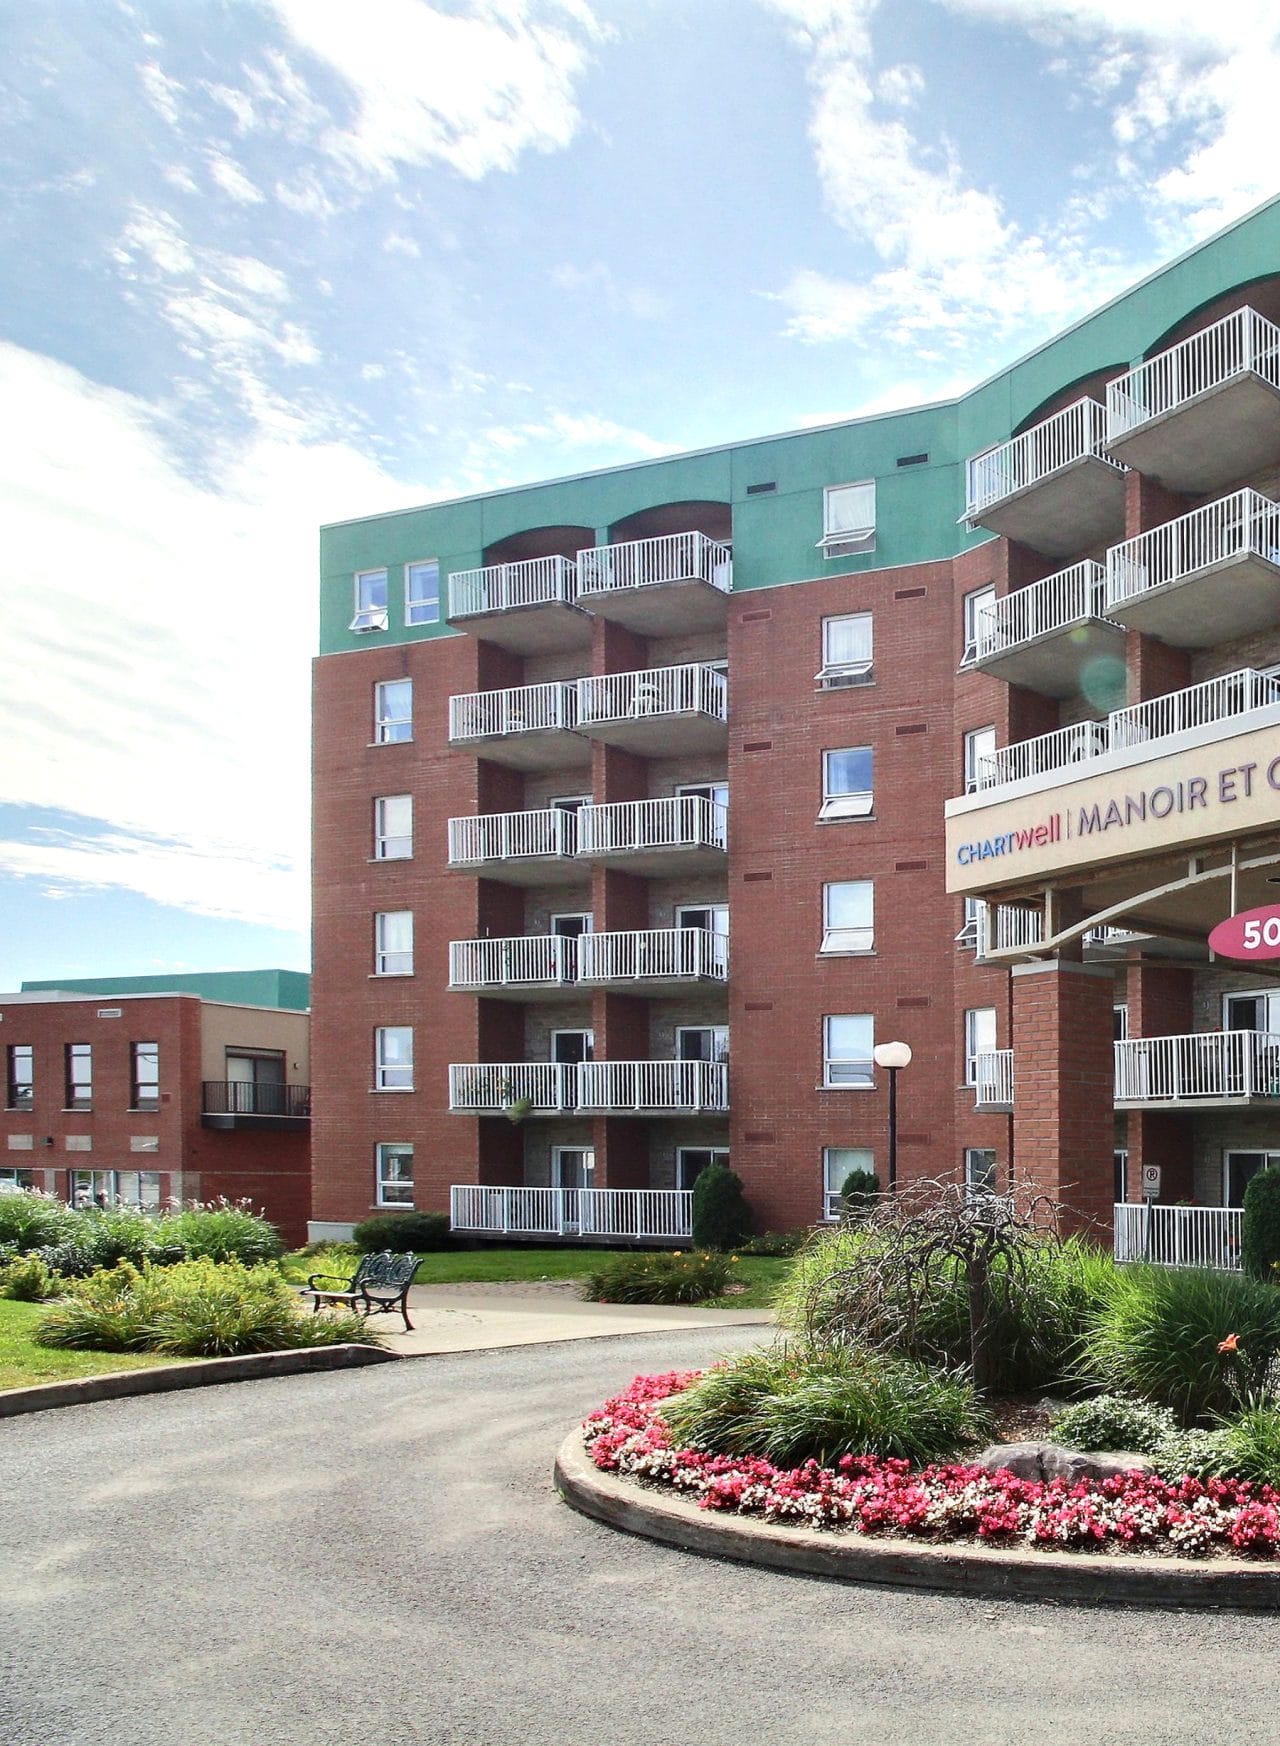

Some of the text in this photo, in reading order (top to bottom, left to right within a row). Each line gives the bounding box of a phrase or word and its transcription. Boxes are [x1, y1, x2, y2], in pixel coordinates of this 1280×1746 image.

[956, 814, 1061, 865] CHARTwell
[1078, 777, 1208, 836] MANOIR
[1218, 762, 1257, 803] ET
